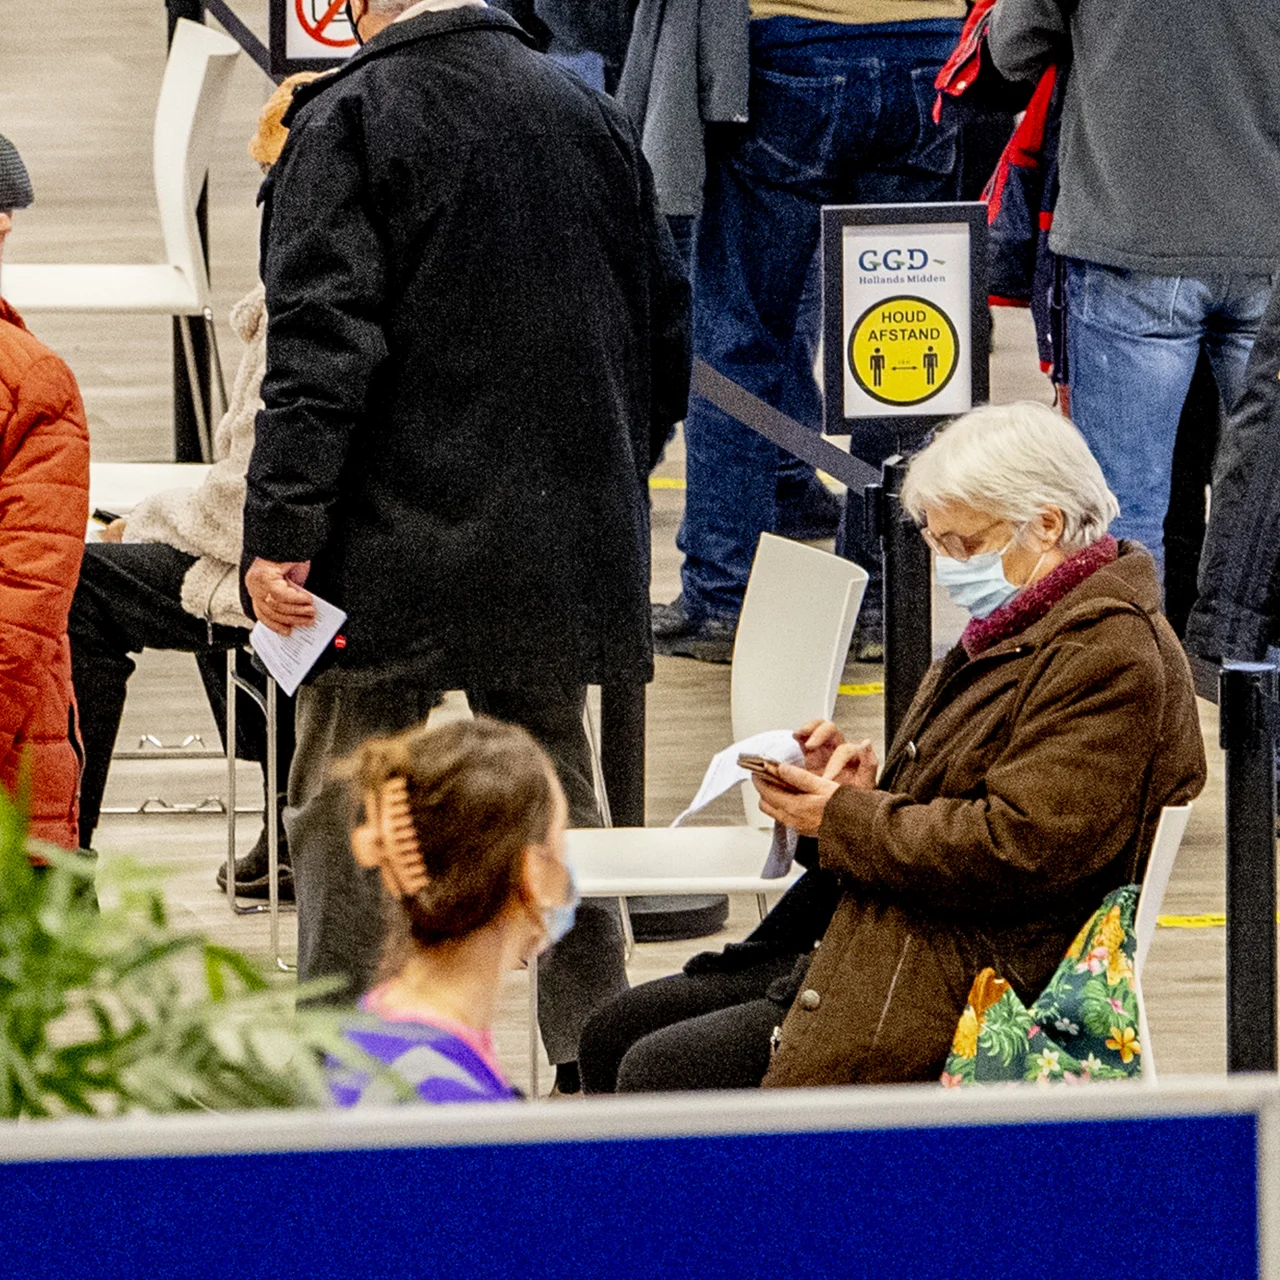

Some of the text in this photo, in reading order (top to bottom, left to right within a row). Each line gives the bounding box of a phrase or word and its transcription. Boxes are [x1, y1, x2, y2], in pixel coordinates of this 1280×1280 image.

[858, 249, 929, 272] GGD
[859, 274, 946, 285] Hollands Midden
[881, 310, 927, 324] HOUD
[868, 328, 941, 343] AFSTAND
